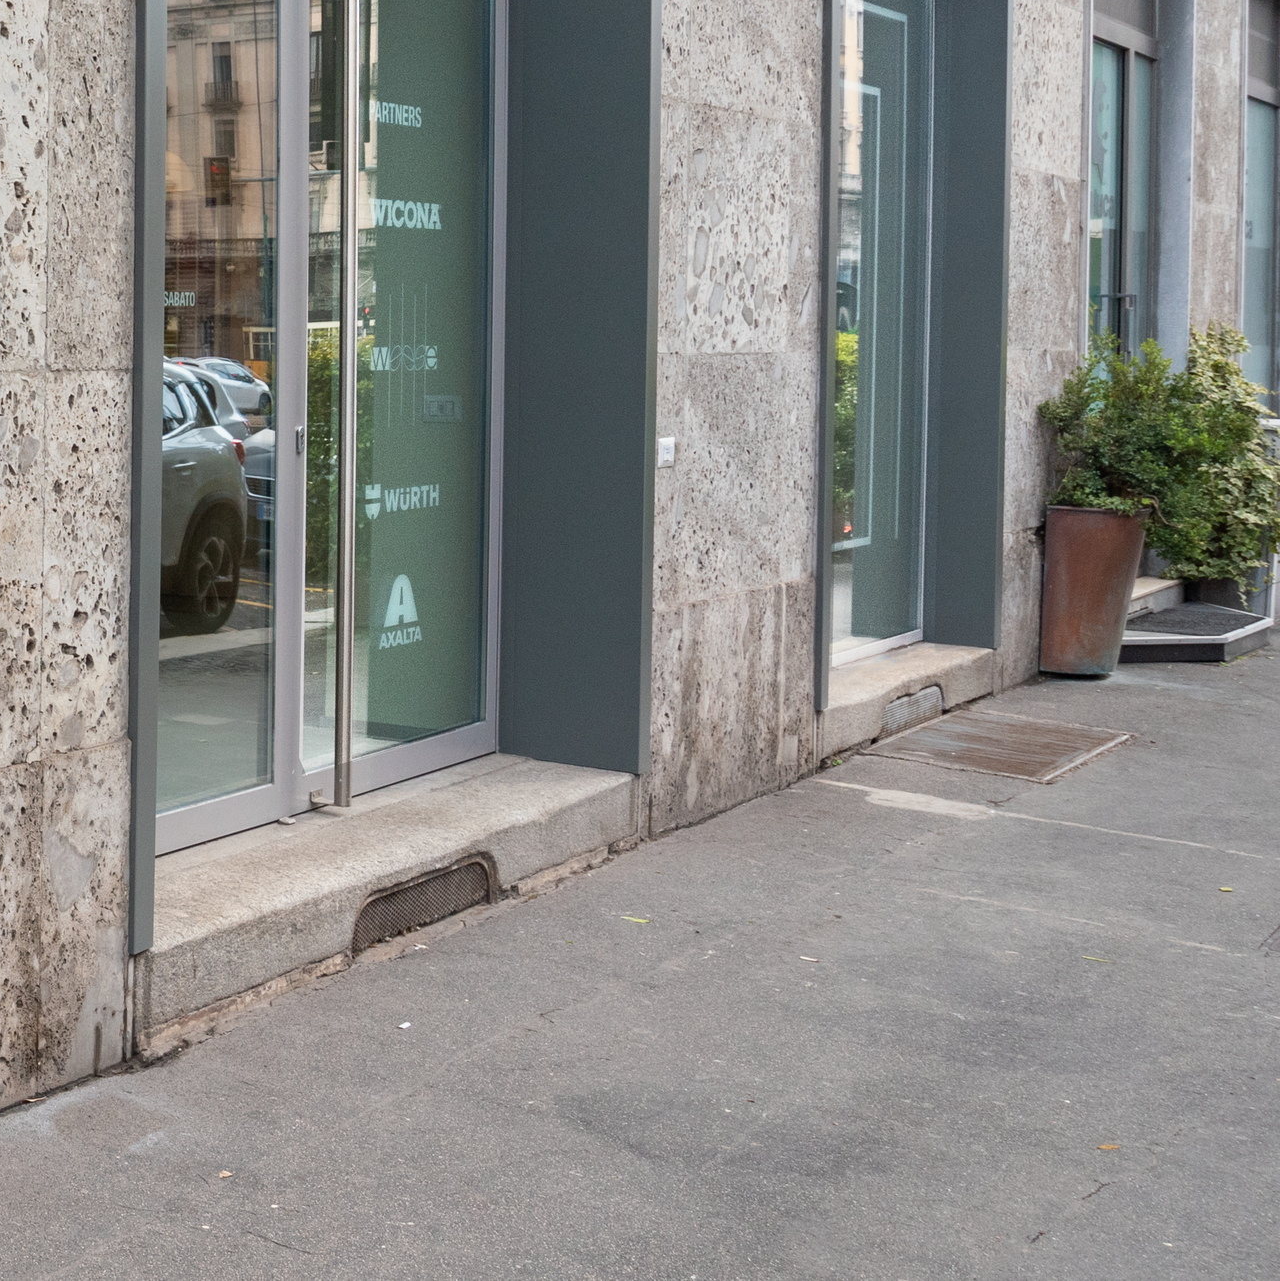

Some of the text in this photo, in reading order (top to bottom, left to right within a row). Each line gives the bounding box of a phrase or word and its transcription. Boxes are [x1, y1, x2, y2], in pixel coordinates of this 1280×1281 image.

[369, 100, 422, 128] PARTNERS
[369, 198, 442, 230] WICONA
[163, 291, 196, 307] SABATO
[379, 625, 423, 650] AXALTA
